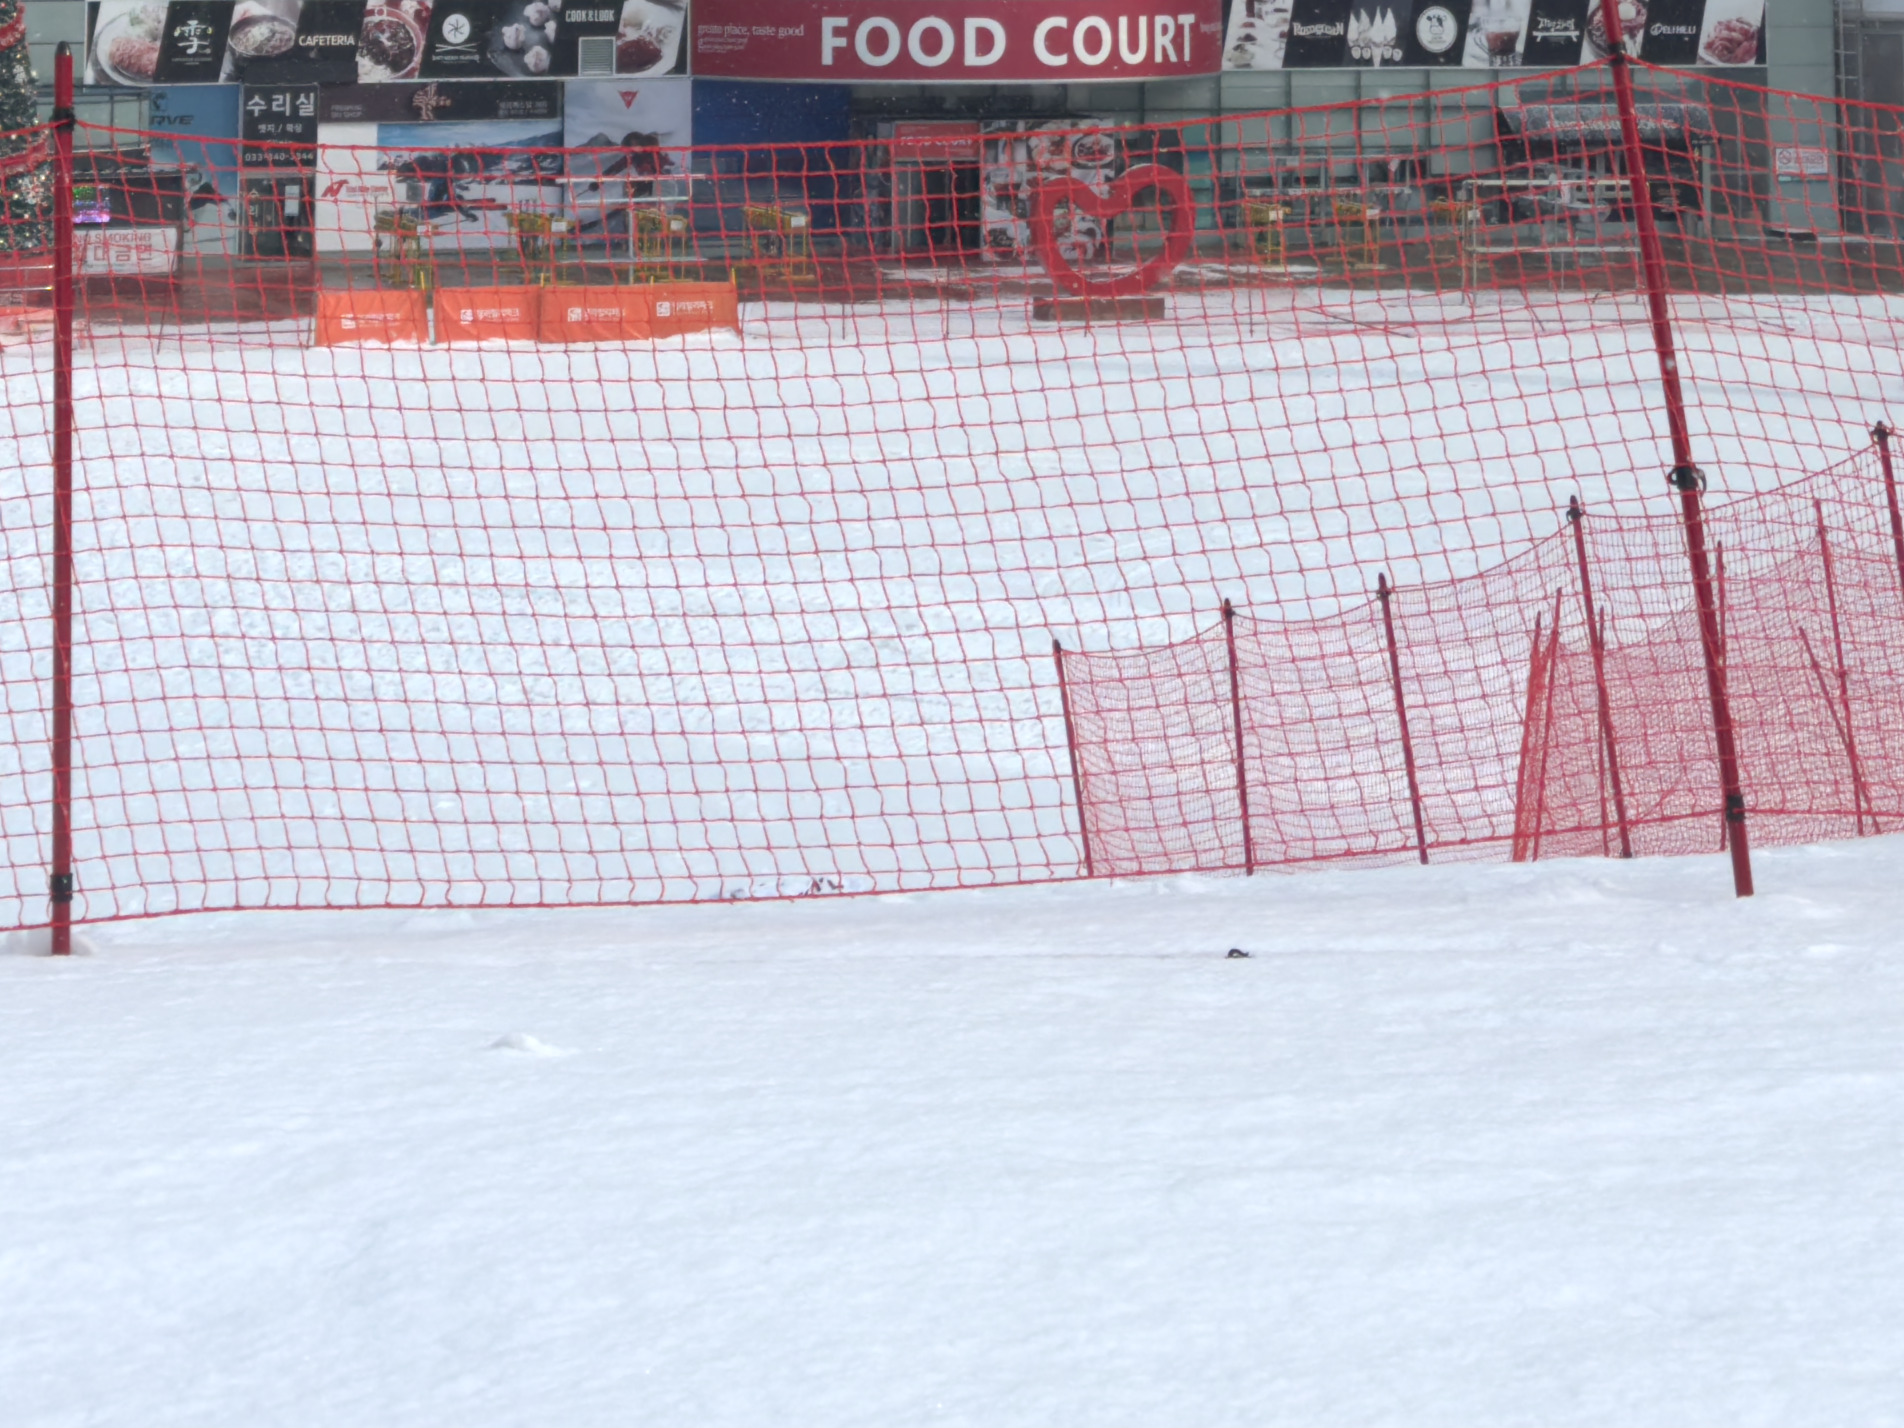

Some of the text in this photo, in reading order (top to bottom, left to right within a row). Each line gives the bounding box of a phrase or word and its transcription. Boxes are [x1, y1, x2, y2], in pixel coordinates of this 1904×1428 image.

[299, 34, 355, 48] CAFETERIA
[821, 14, 1195, 67] FOOD COURT
[246, 93, 315, 116] 수리실
